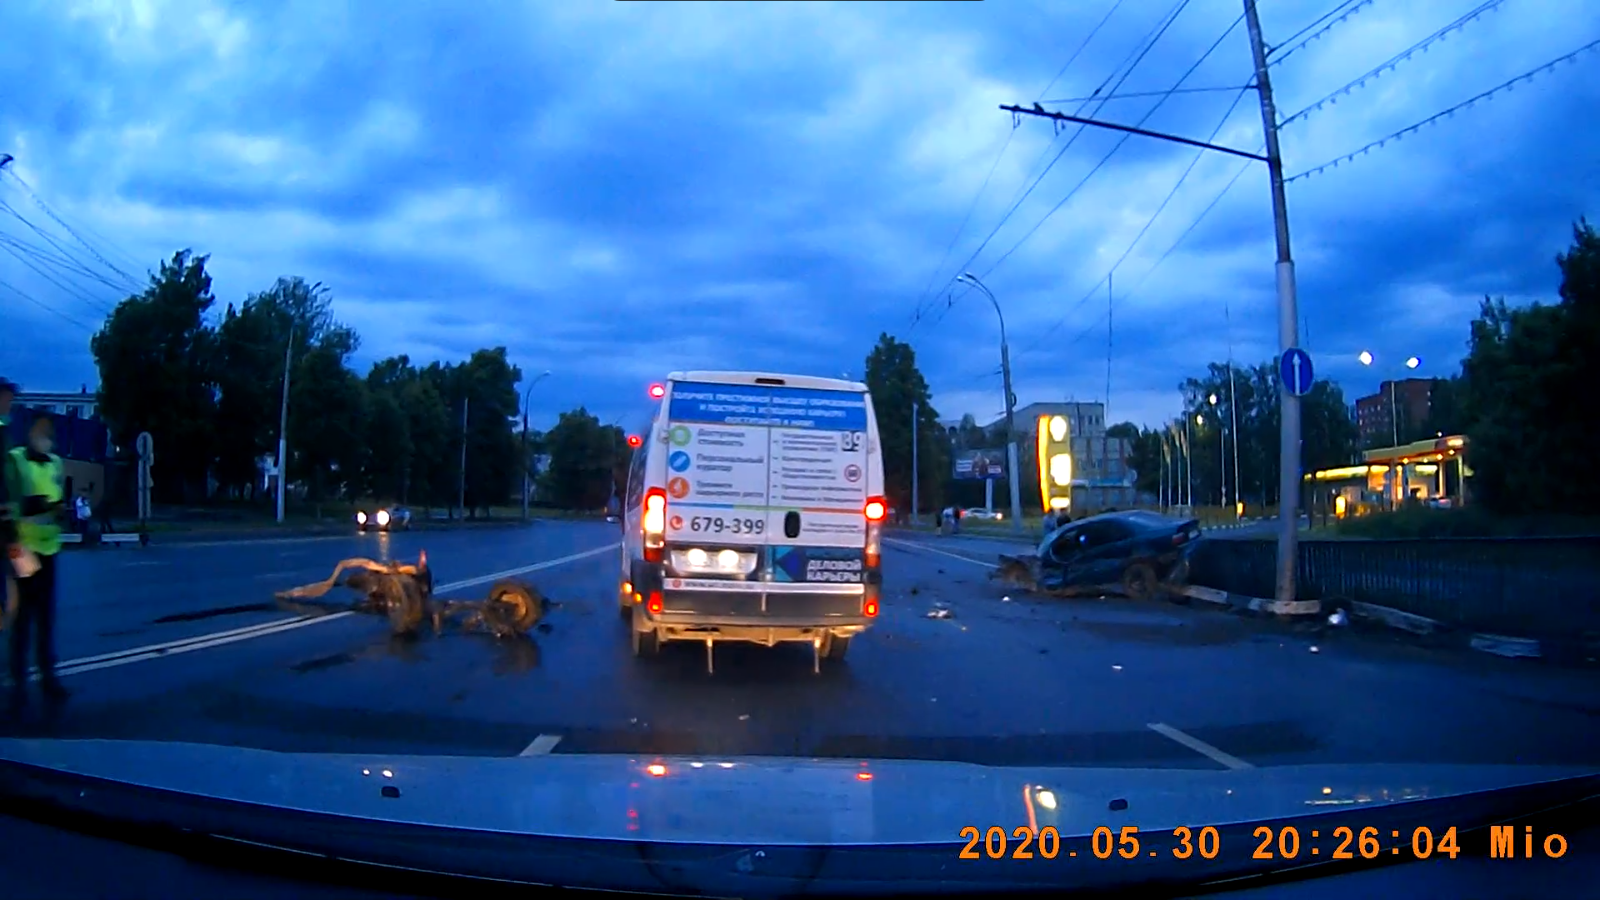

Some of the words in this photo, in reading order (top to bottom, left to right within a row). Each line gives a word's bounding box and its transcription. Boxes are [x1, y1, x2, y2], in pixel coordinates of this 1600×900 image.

[690, 516, 765, 535] 679-399
[807, 559, 862, 571] ДЕЛОВОЙ
[806, 571, 861, 582] КАРЬЕРЫ
